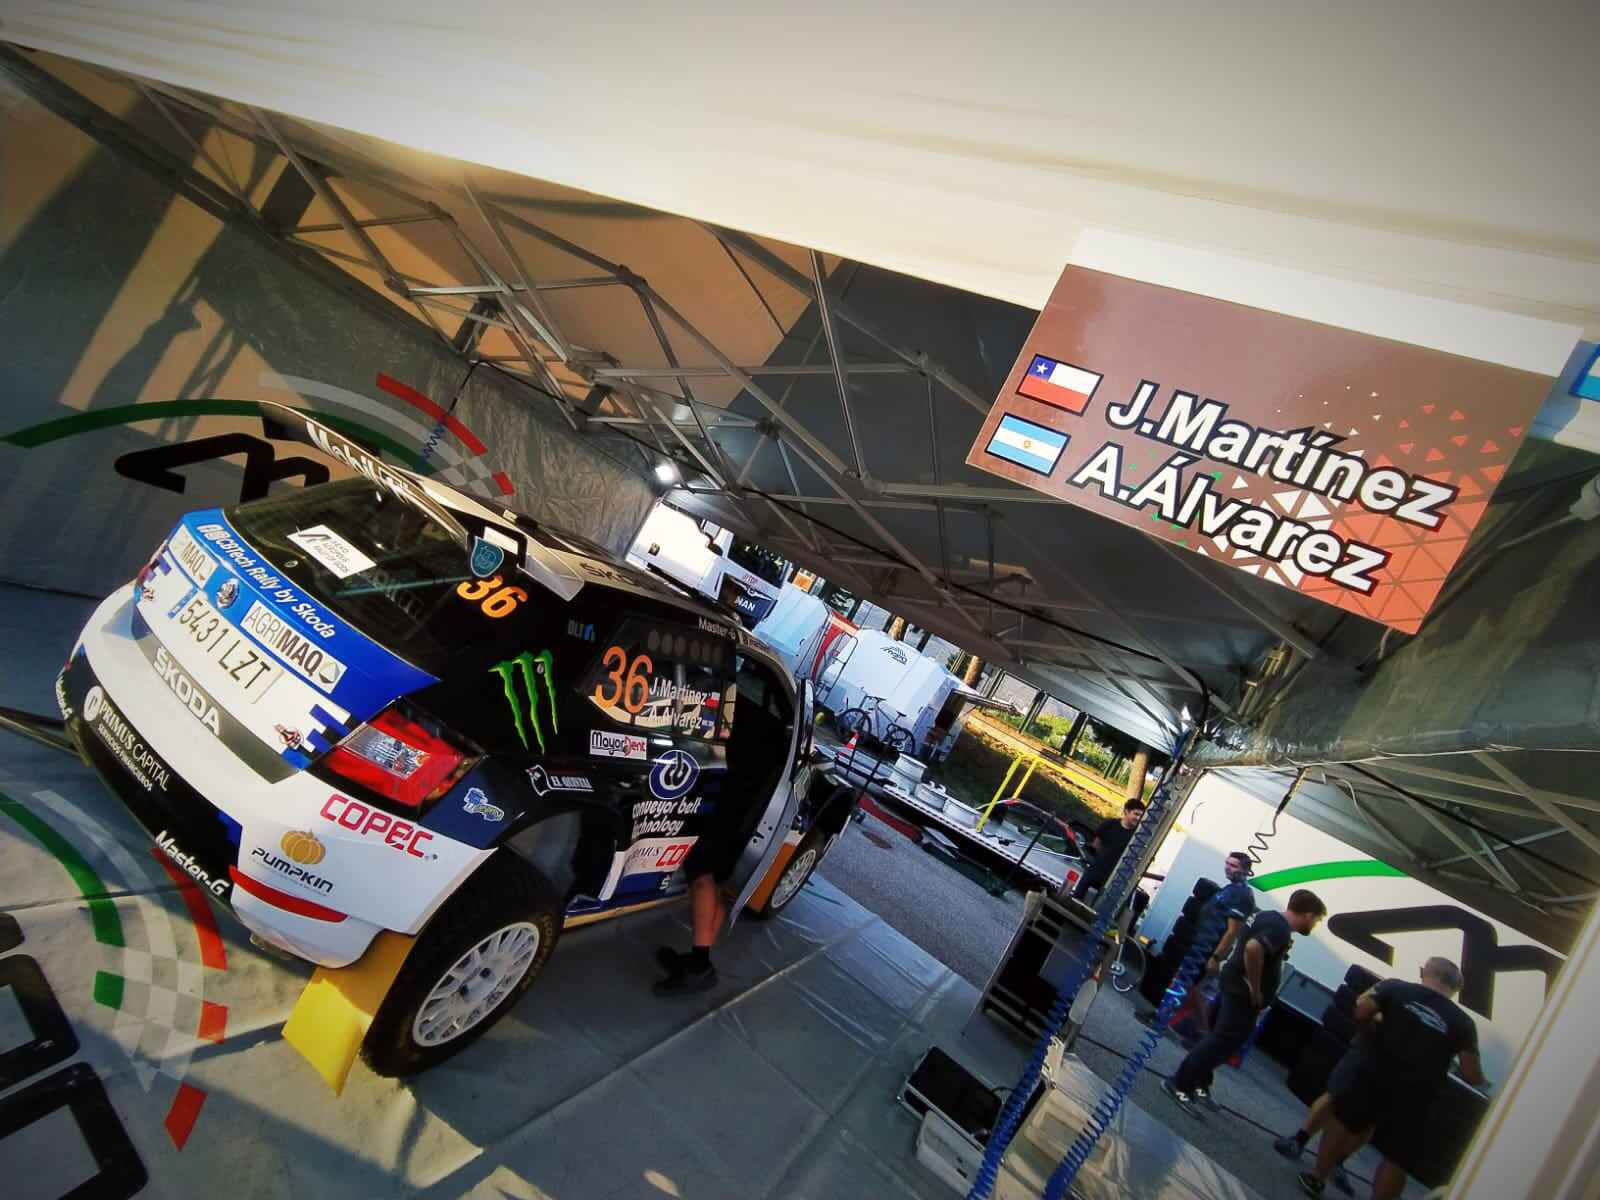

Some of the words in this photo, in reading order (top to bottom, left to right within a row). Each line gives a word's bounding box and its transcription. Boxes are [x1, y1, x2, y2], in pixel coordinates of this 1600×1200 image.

[1107, 380, 1458, 532] J.Martínez
[1067, 441, 1392, 596] A.Álvarez
[245, 566, 282, 590] Rally
[273, 588, 299, 603] by
[291, 602, 335, 638] Skoda
[456, 575, 528, 618] 36
[180, 599, 229, 653] 5431
[218, 640, 271, 689] LZT
[246, 606, 323, 676] AGRIMAQ
[595, 646, 653, 714] 36
[100, 700, 136, 750] PRIMUS
[133, 743, 169, 791] CAPITAL
[155, 830, 230, 896] Master-G
